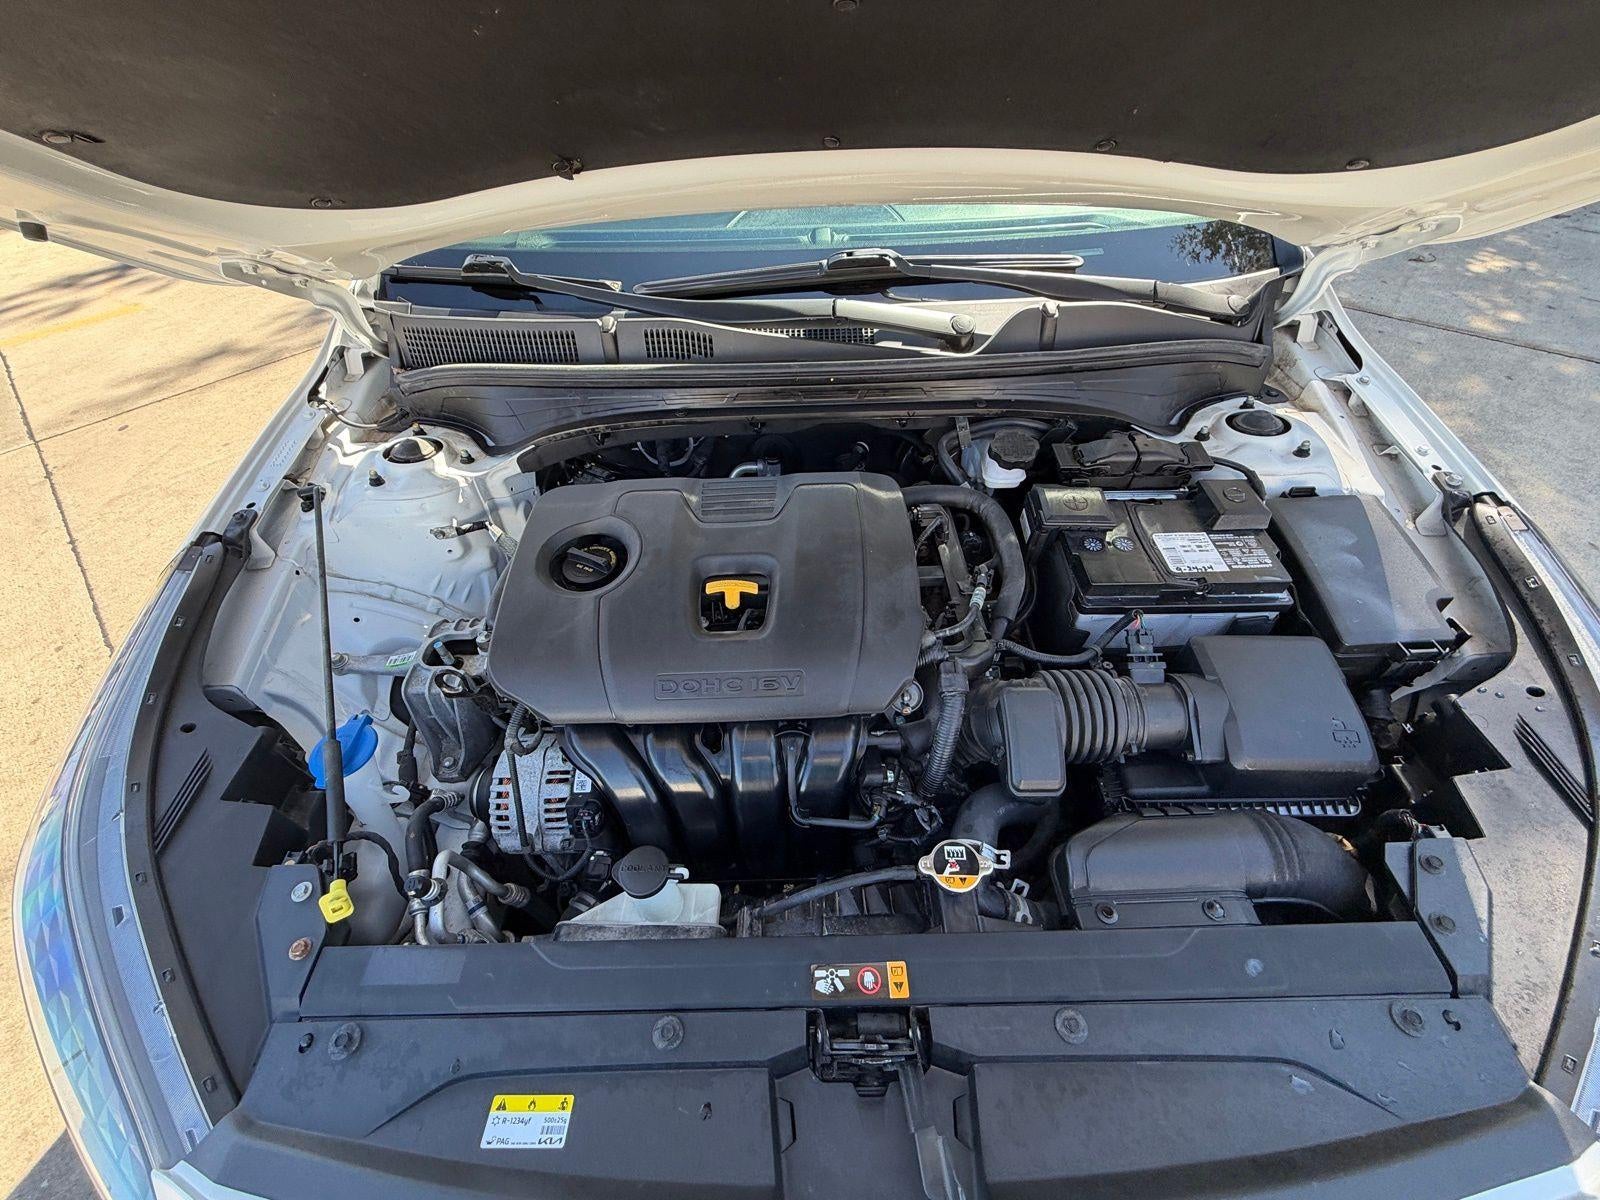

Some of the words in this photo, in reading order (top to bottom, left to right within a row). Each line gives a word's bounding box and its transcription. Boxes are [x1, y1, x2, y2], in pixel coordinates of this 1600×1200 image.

[656, 677, 744, 695] DOHC
[750, 674, 801, 692] 16V
[620, 863, 667, 873] COOLANT
[501, 1117, 532, 1126] R-1234yf
[496, 1137, 510, 1146] PAG
[537, 1137, 563, 1145] KIA
